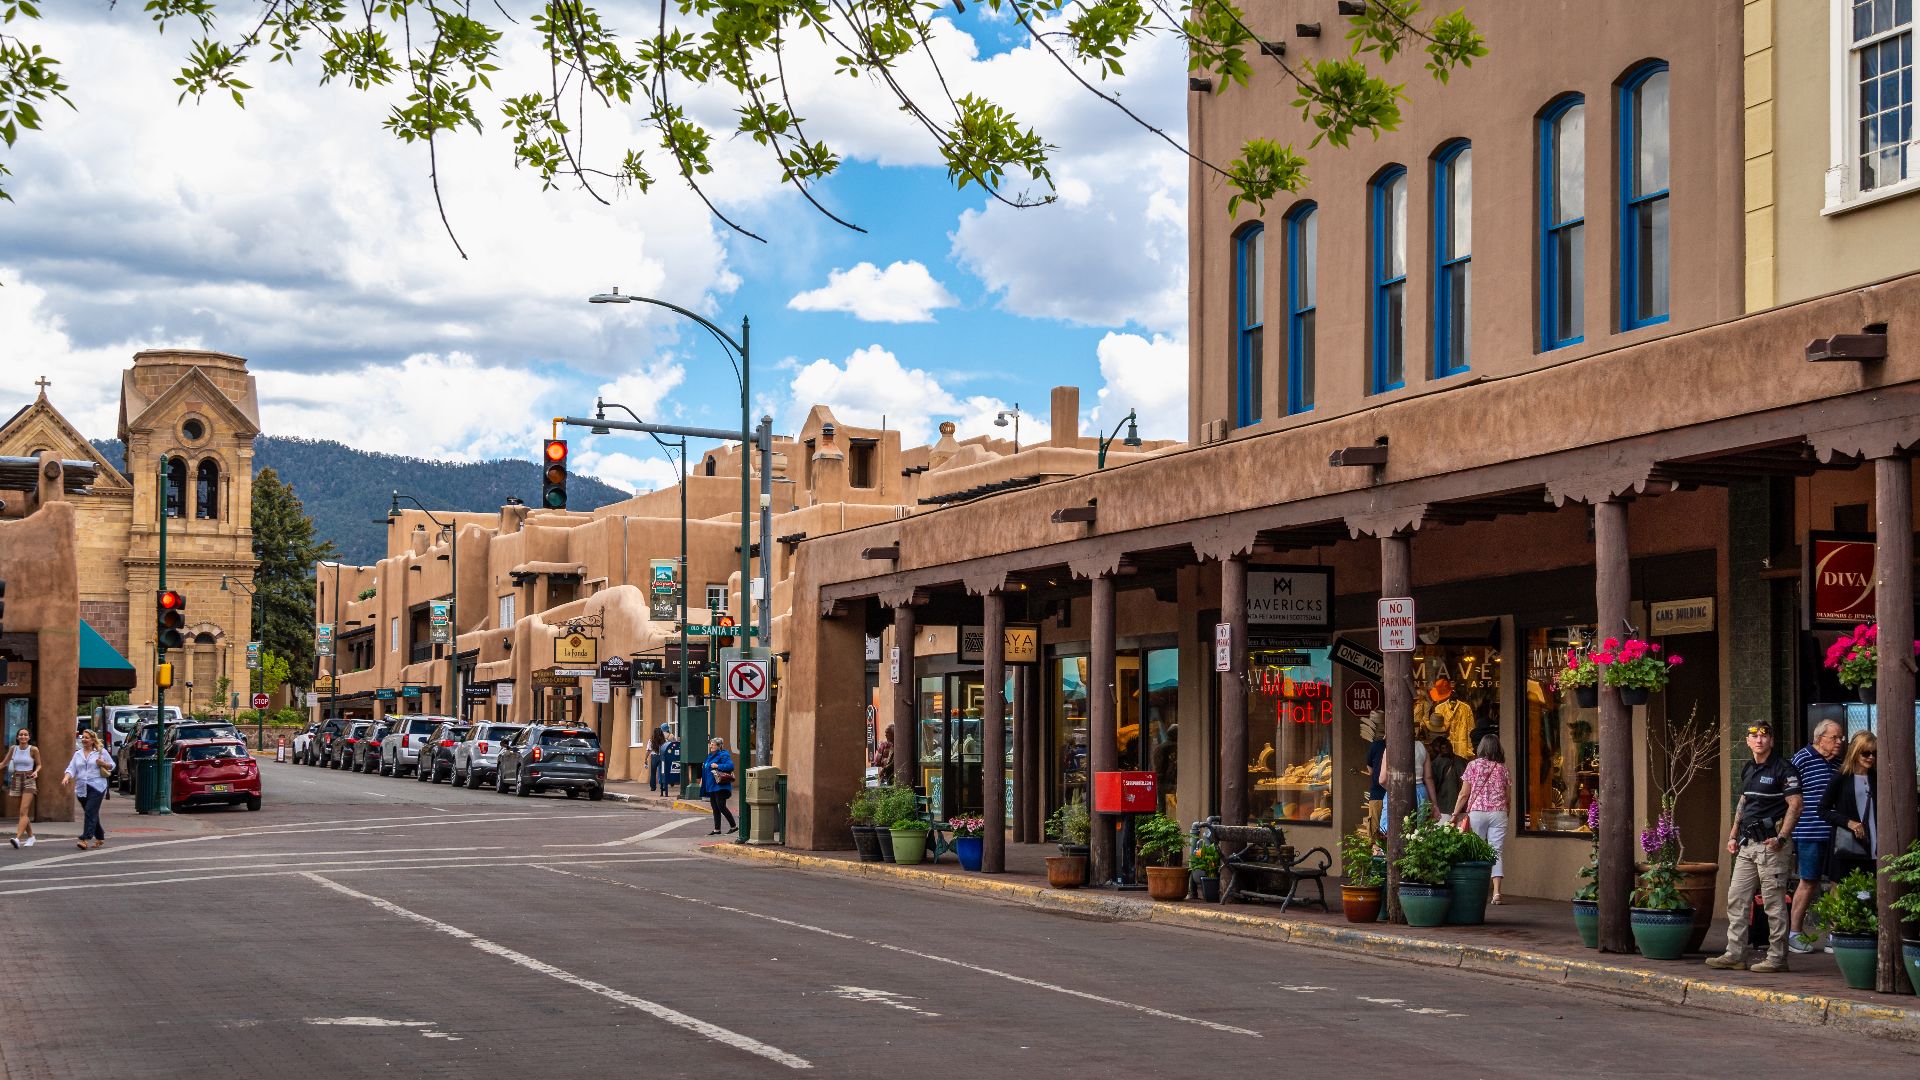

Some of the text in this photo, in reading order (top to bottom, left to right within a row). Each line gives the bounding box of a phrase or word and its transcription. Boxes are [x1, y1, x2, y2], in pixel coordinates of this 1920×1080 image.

[1824, 571, 1868, 587] DIVA
[1247, 598, 1322, 611] MAVERICKS
[1389, 603, 1403, 614] NO
[1676, 606, 1707, 620] BUILDING
[1381, 617, 1412, 627] PARKING
[701, 625, 727, 636] SANTA
[730, 626, 740, 636] FE
[1390, 629, 1403, 637] ANY
[1004, 633, 1034, 647] AYA
[1389, 638, 1405, 646] TIME
[1262, 654, 1304, 664] Furniture
[1340, 647, 1384, 674] ONE WAY
[1353, 688, 1372, 699] HAT
[1353, 699, 1372, 710] BAR
